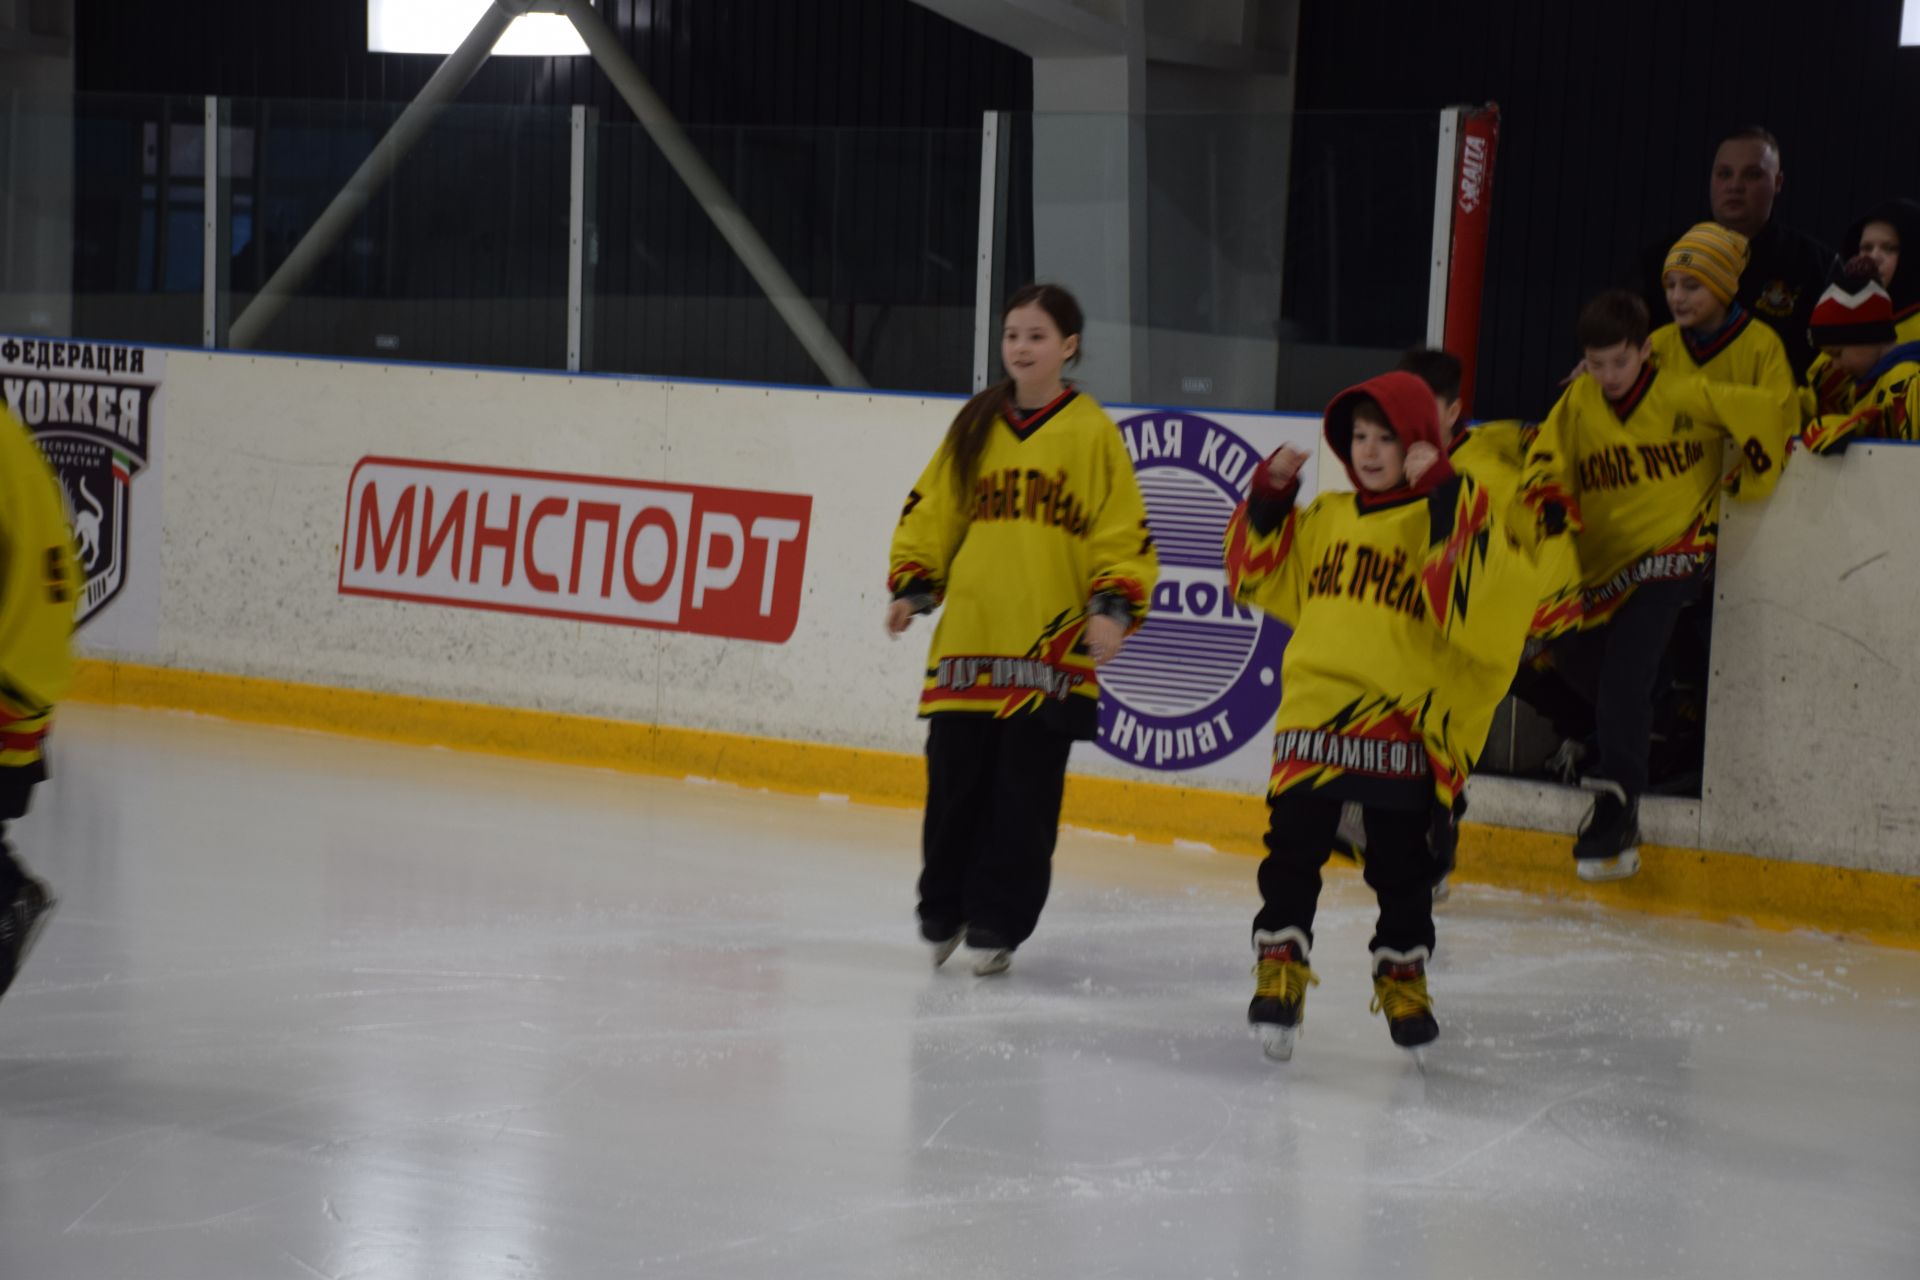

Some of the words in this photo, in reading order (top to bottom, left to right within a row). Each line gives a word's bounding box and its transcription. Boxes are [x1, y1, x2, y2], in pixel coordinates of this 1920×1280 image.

[1, 339, 145, 375] ФЕДЕРАЦИЯ
[2, 377, 141, 446] ХОККЕЯ
[35, 440, 106, 456] РЕСПУБЛИКИ
[1744, 437, 1773, 475] 8
[353, 480, 801, 618] МИНСПОРТ
